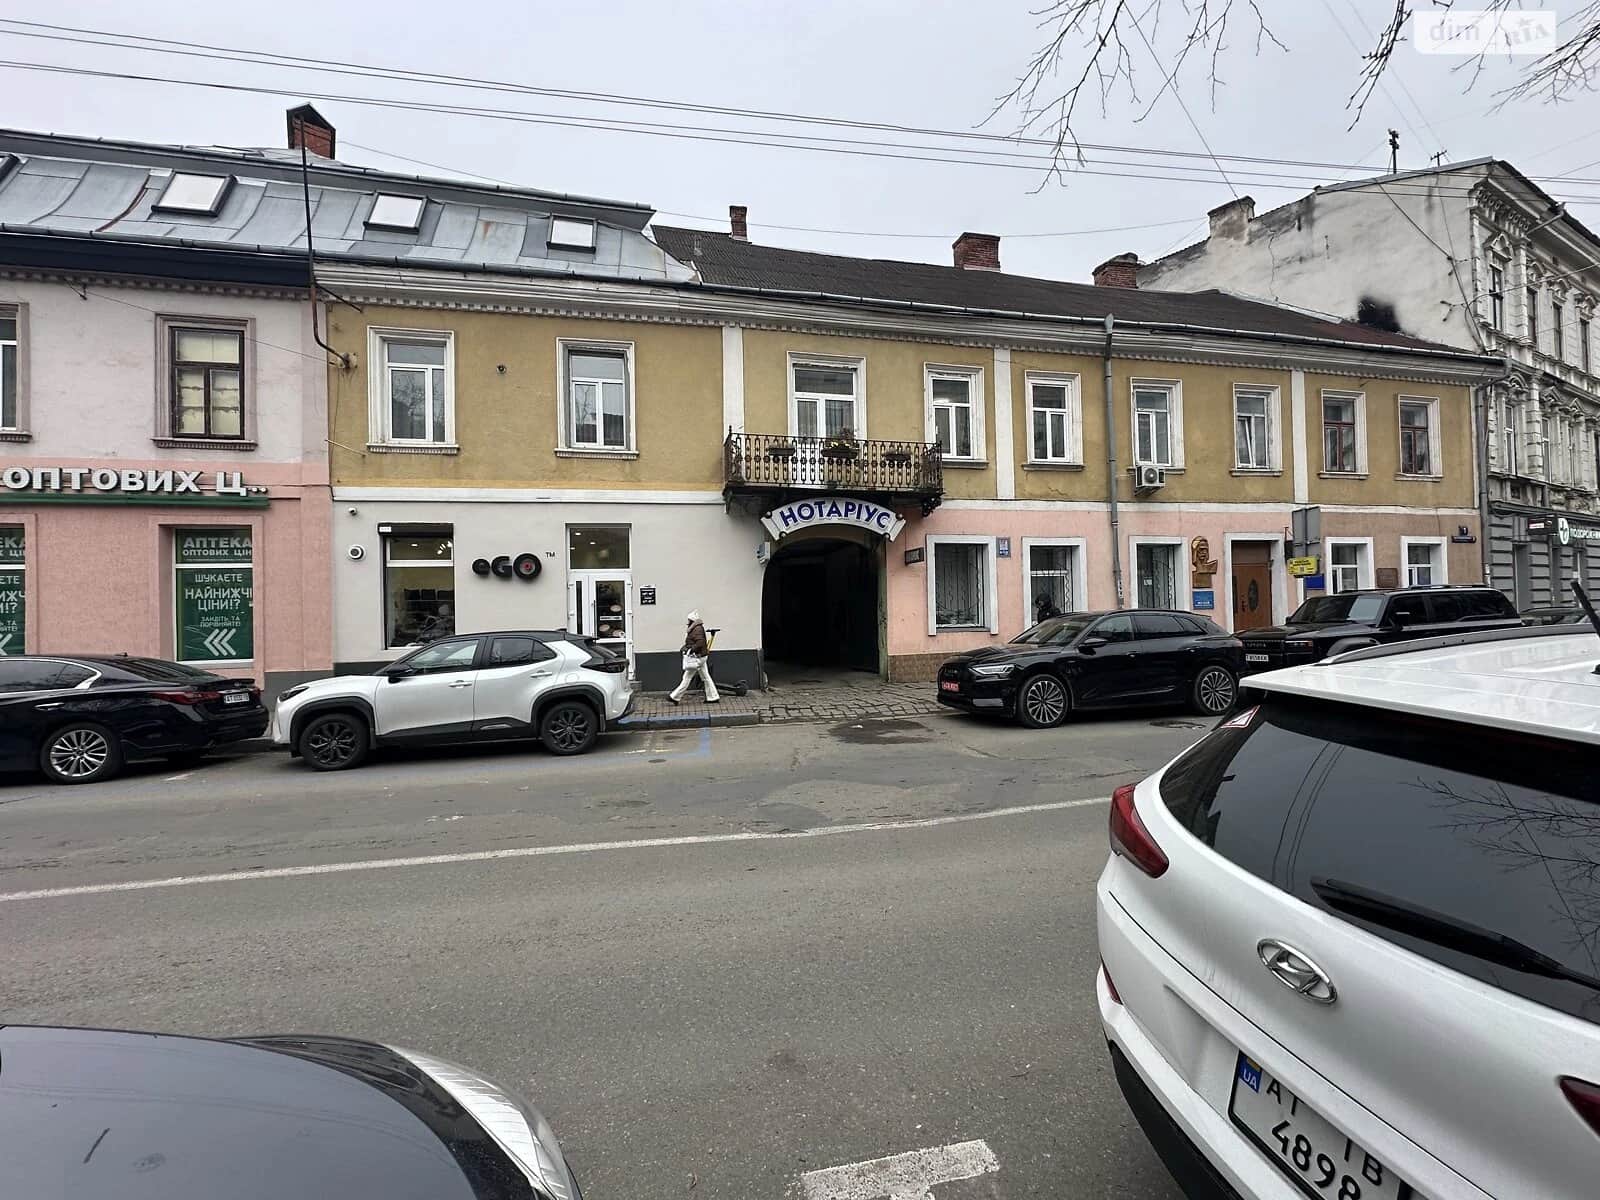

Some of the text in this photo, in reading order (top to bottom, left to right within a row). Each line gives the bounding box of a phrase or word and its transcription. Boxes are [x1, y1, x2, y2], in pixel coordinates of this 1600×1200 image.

[2, 467, 203, 492] ОПТОВИХ
[779, 499, 891, 529] НОТАРІУС
[183, 537, 252, 548] АПТЕКА
[194, 573, 243, 582] ШУКАЄТЕ
[184, 586, 253, 599] НАЙНИЖЧІ
[198, 599, 241, 612] ЦІНИ!?
[1243, 1068, 1257, 1090] UA
[1271, 1120, 1361, 1200] 4898
